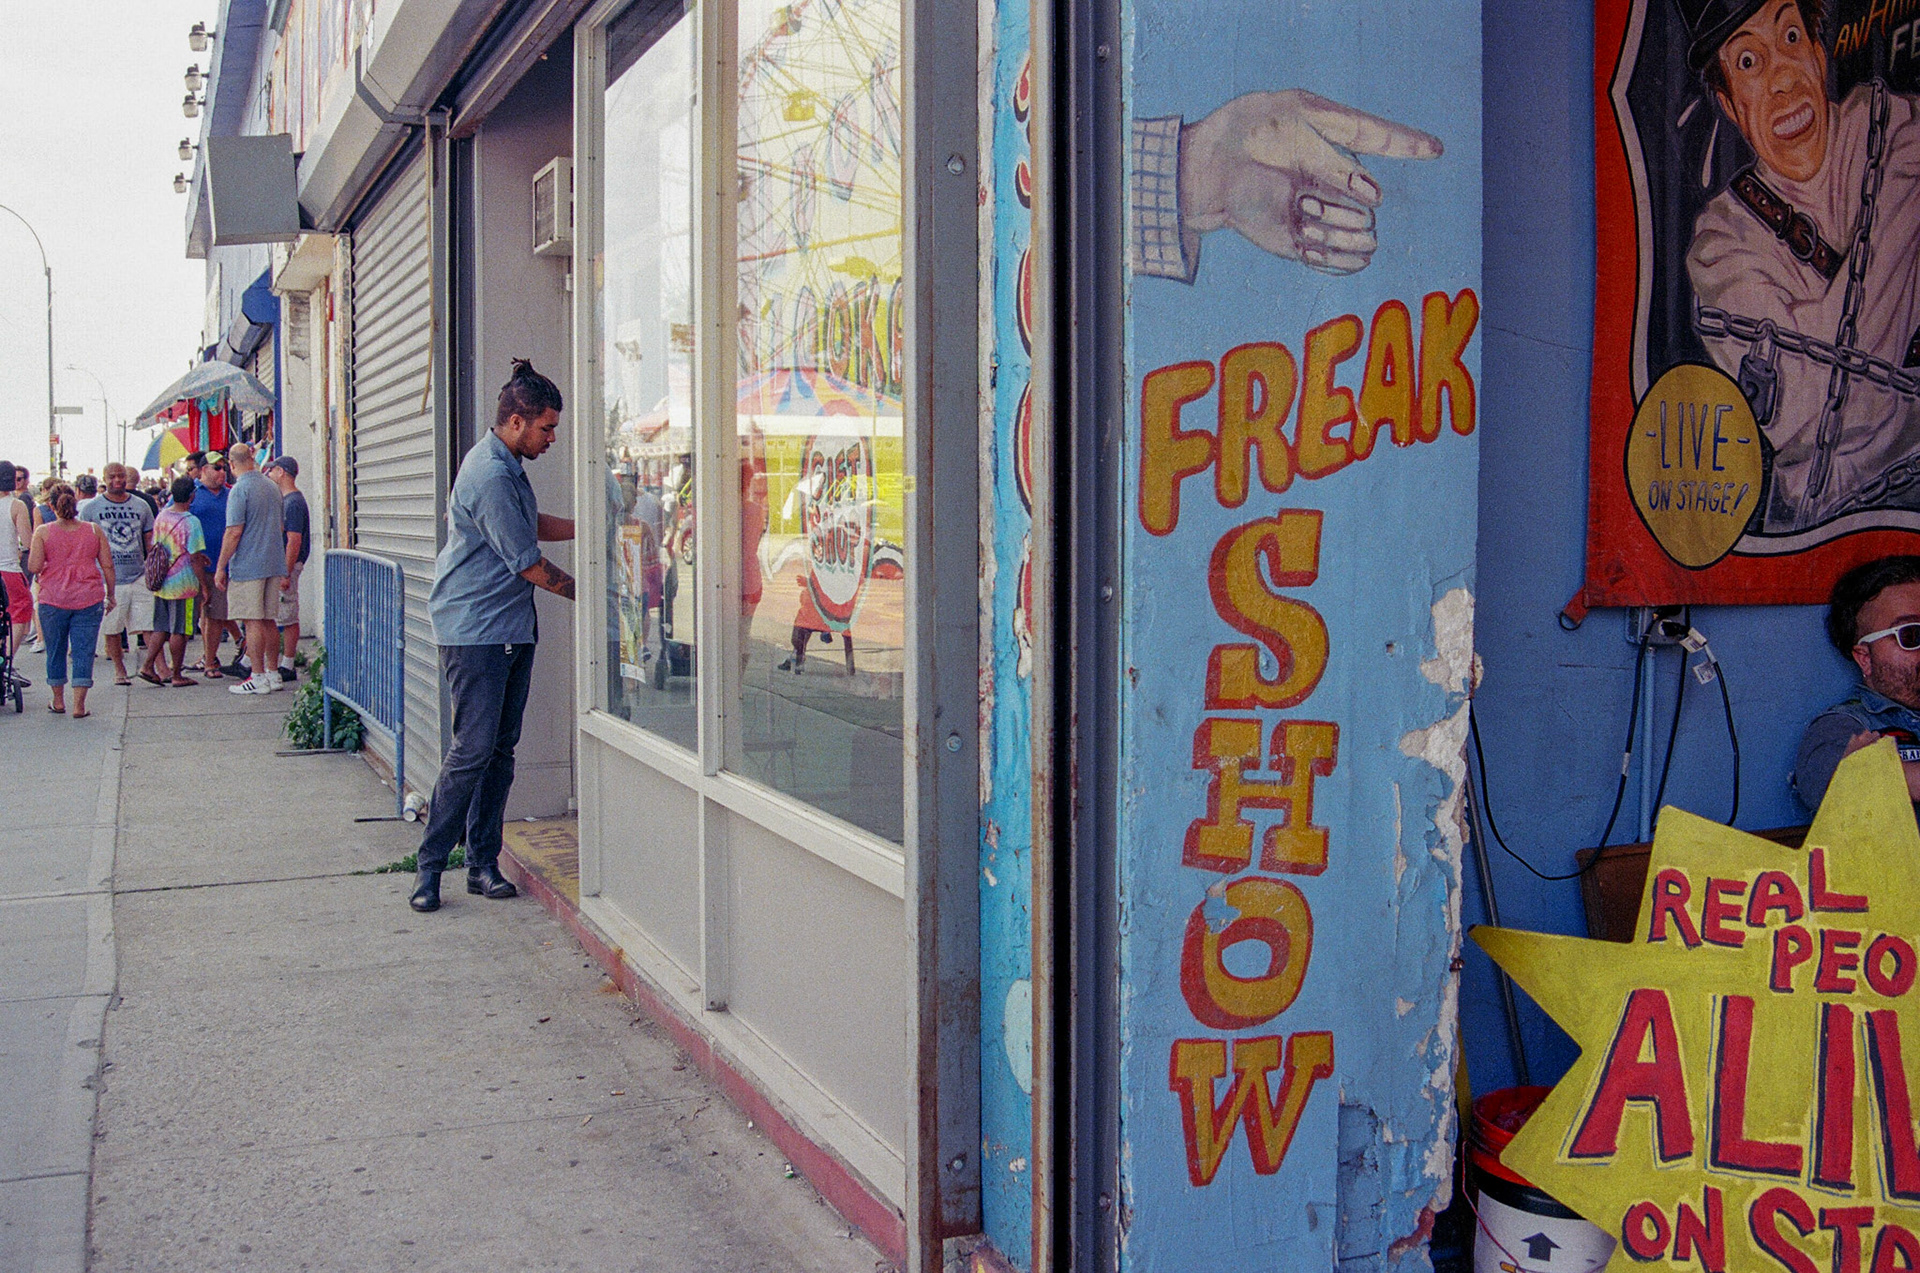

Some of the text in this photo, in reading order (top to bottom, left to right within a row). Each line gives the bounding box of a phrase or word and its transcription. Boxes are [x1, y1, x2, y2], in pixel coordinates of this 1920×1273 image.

[1833, 15, 1866, 59] AN
[1138, 288, 1479, 536] FREAK
[810, 442, 860, 504] GIFT
[1649, 480, 1749, 517] ON STAGE!
[98, 511, 141, 520] LOYALTY
[1168, 508, 1341, 1186] SHOW
[1647, 848, 1869, 949] REAL
[1769, 924, 1918, 997] PEO
[1622, 1184, 1726, 1273] ON
